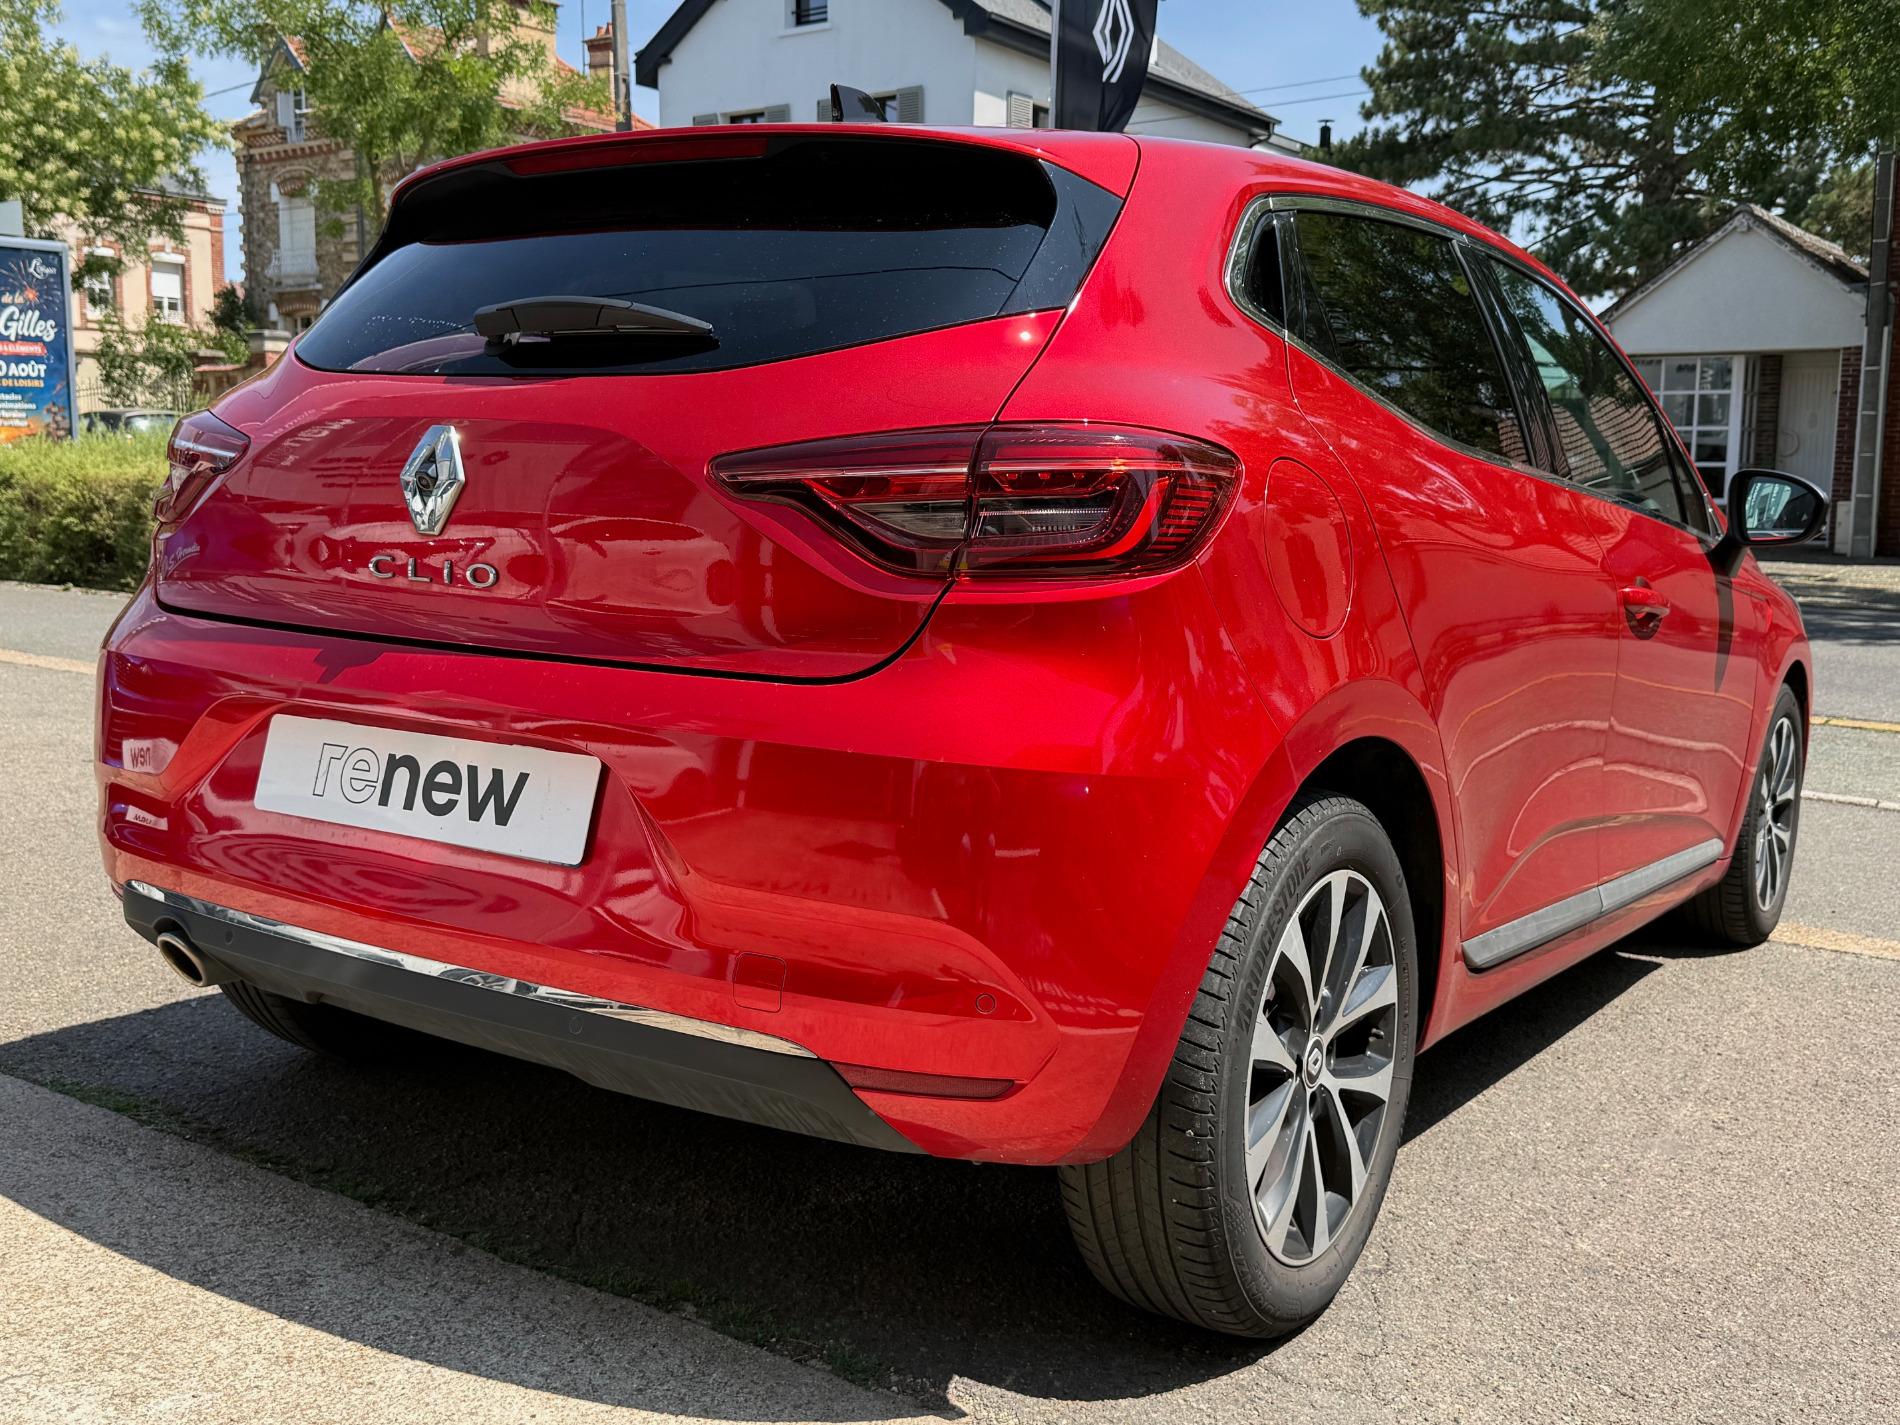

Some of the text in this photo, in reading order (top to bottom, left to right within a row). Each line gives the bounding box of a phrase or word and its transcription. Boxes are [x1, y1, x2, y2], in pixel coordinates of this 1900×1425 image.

[0, 305, 58, 342] Gilles
[8, 360, 47, 378] AOÛT
[368, 555, 498, 588] CLIO
[312, 742, 531, 827] renew
[1235, 852, 1313, 1033] BRIDGESTONE
